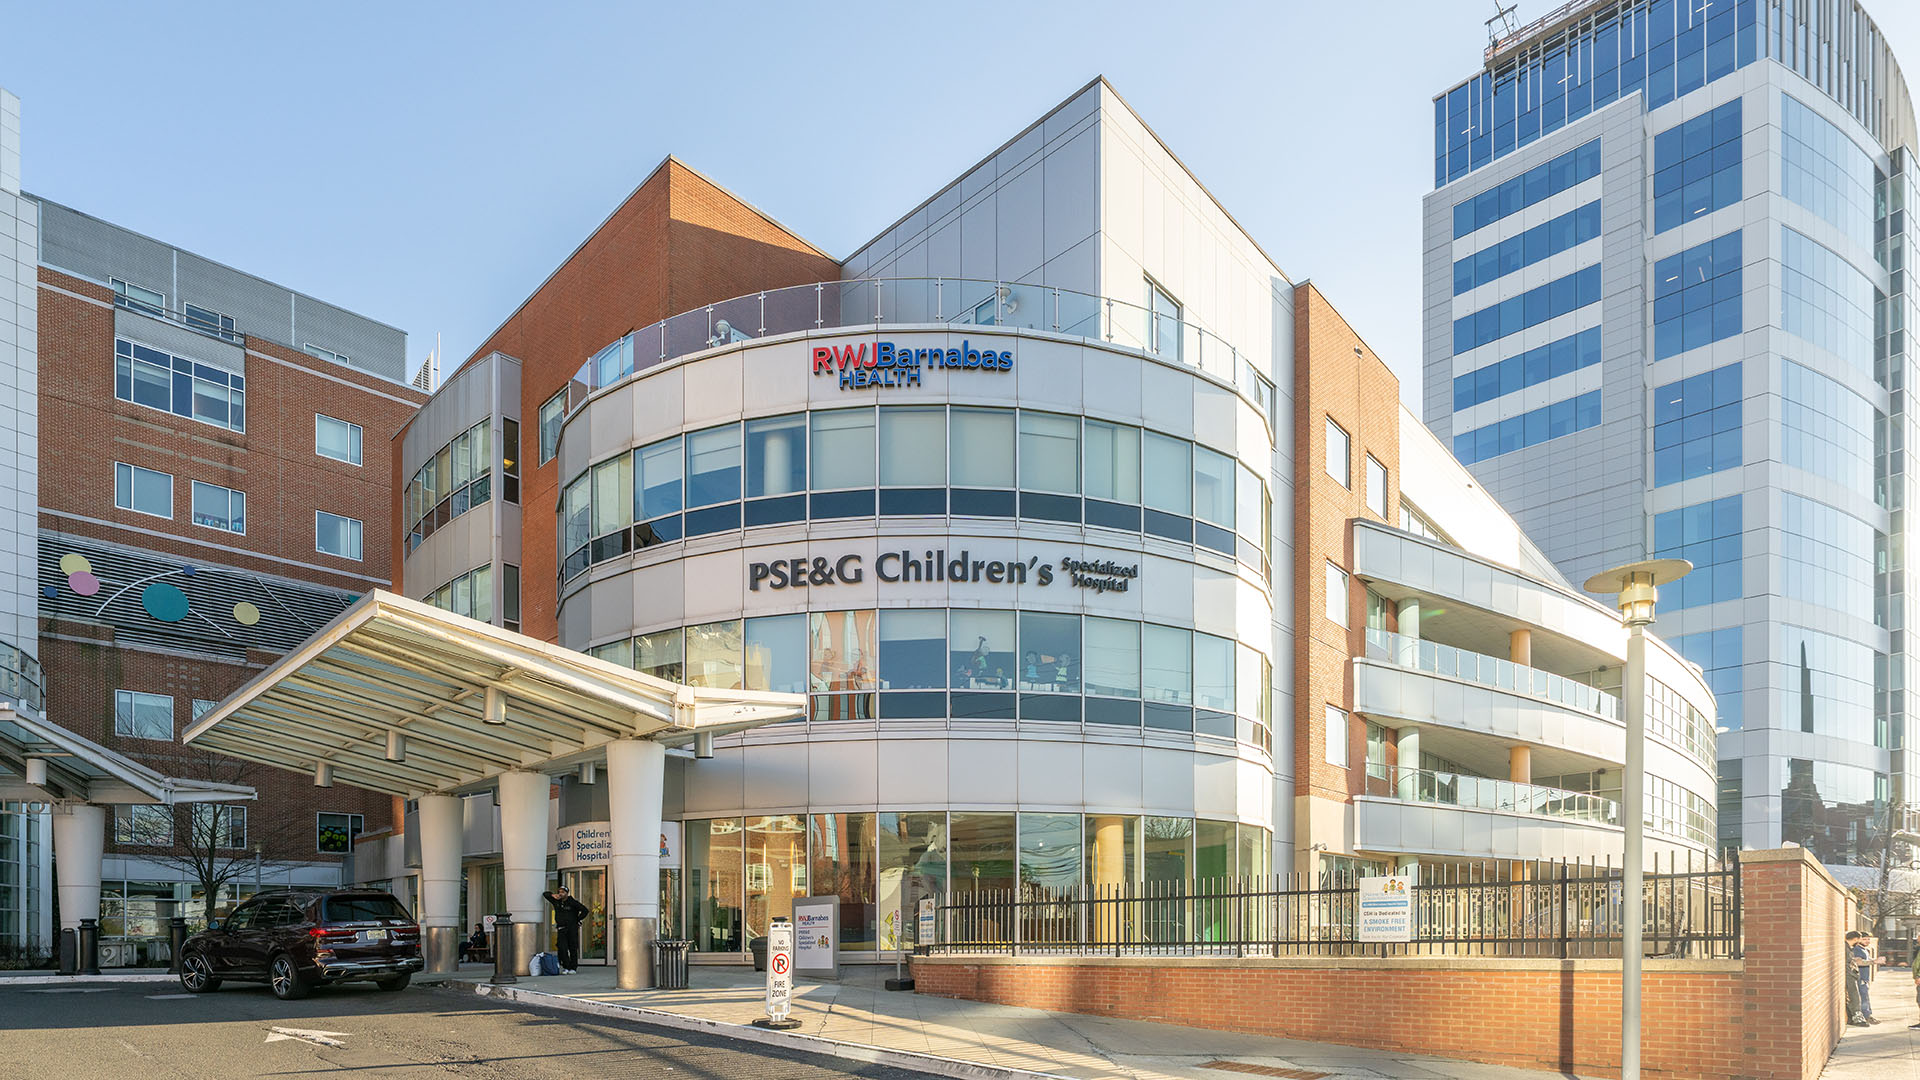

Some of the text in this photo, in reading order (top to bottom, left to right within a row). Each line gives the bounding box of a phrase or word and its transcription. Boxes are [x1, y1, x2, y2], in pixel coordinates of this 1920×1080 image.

[812, 340, 1014, 374] RWJBarnabas
[839, 368, 922, 389] HEALTH
[749, 550, 1054, 591] PSE&G Children's
[1062, 556, 1138, 578] Specialized
[1072, 574, 1129, 594] Hospital
[576, 829, 611, 840] Children
[576, 841, 612, 851] Specializ
[576, 851, 610, 862] Hospital
[774, 981, 786, 989] FIRE
[772, 990, 787, 998] ZONE
